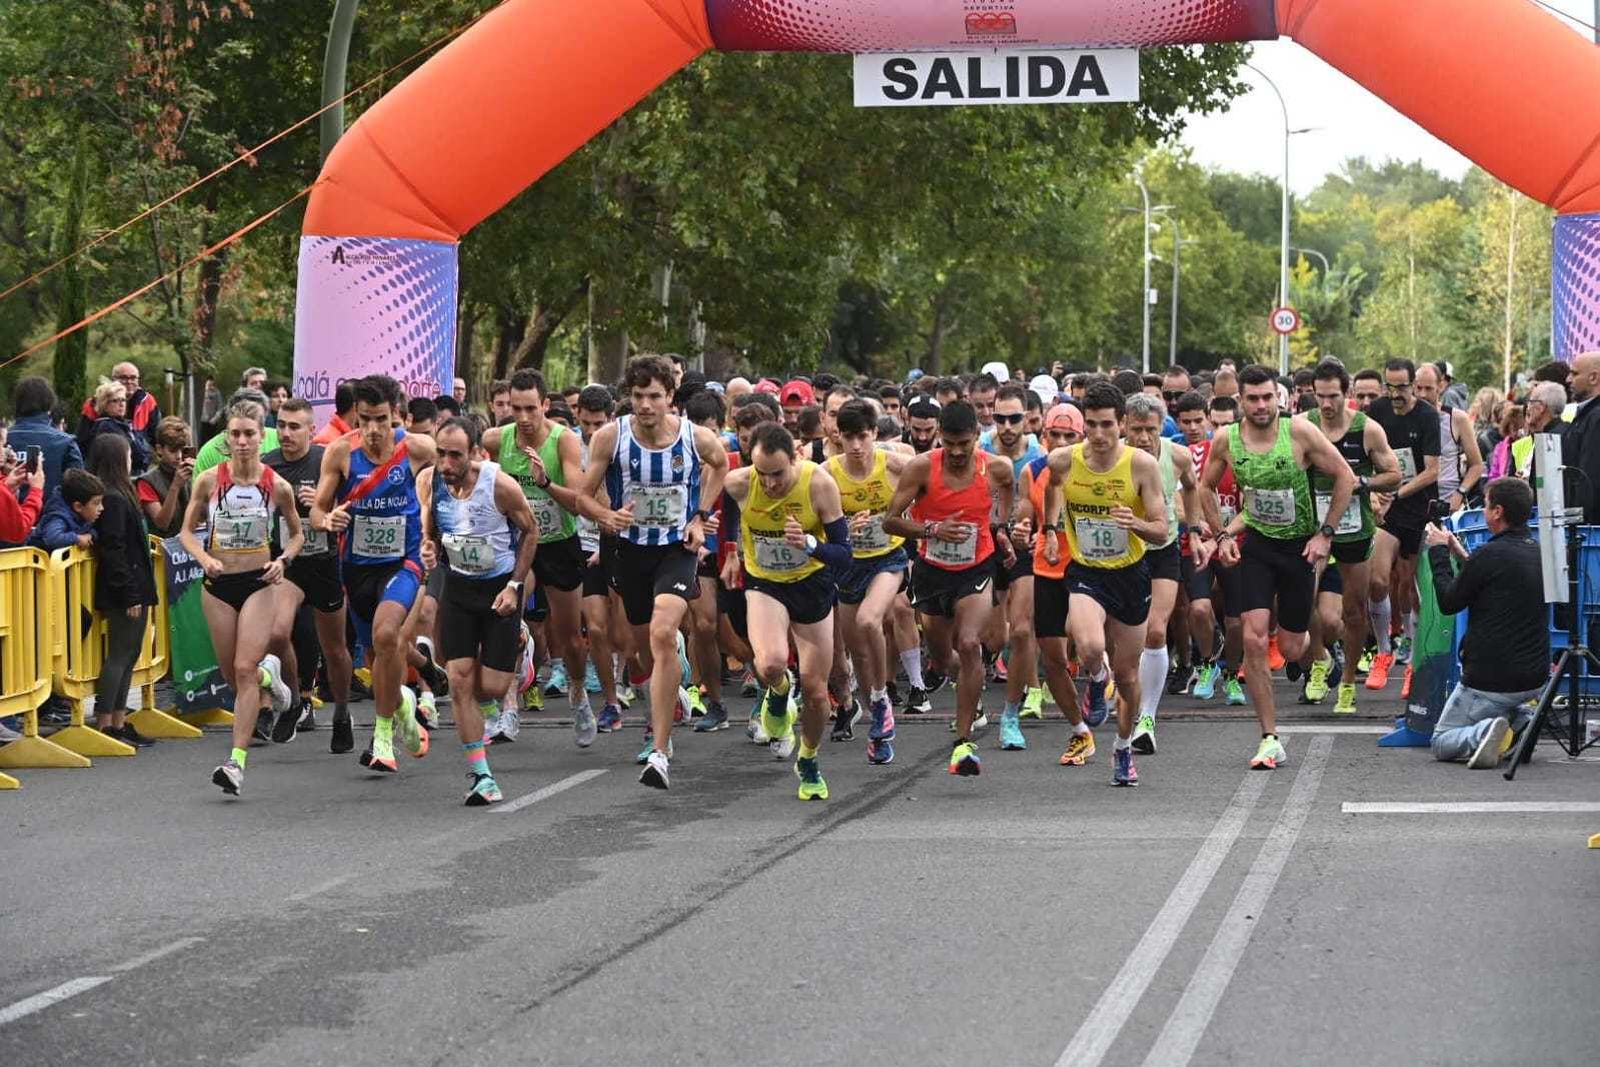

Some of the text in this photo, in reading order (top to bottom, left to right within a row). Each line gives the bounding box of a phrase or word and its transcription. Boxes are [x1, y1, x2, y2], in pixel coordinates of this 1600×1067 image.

[882, 55, 1110, 100] SALIDA
[1278, 316, 1292, 326] 30
[374, 497, 386, 509] DE
[388, 496, 408, 508] NOJA
[646, 499, 667, 515] 15
[1070, 502, 1110, 514] SCORPI
[1255, 498, 1285, 515] 825
[364, 528, 396, 545] 328
[1092, 530, 1112, 547] 18
[461, 547, 479, 563] 14
[771, 548, 792, 562] 16
